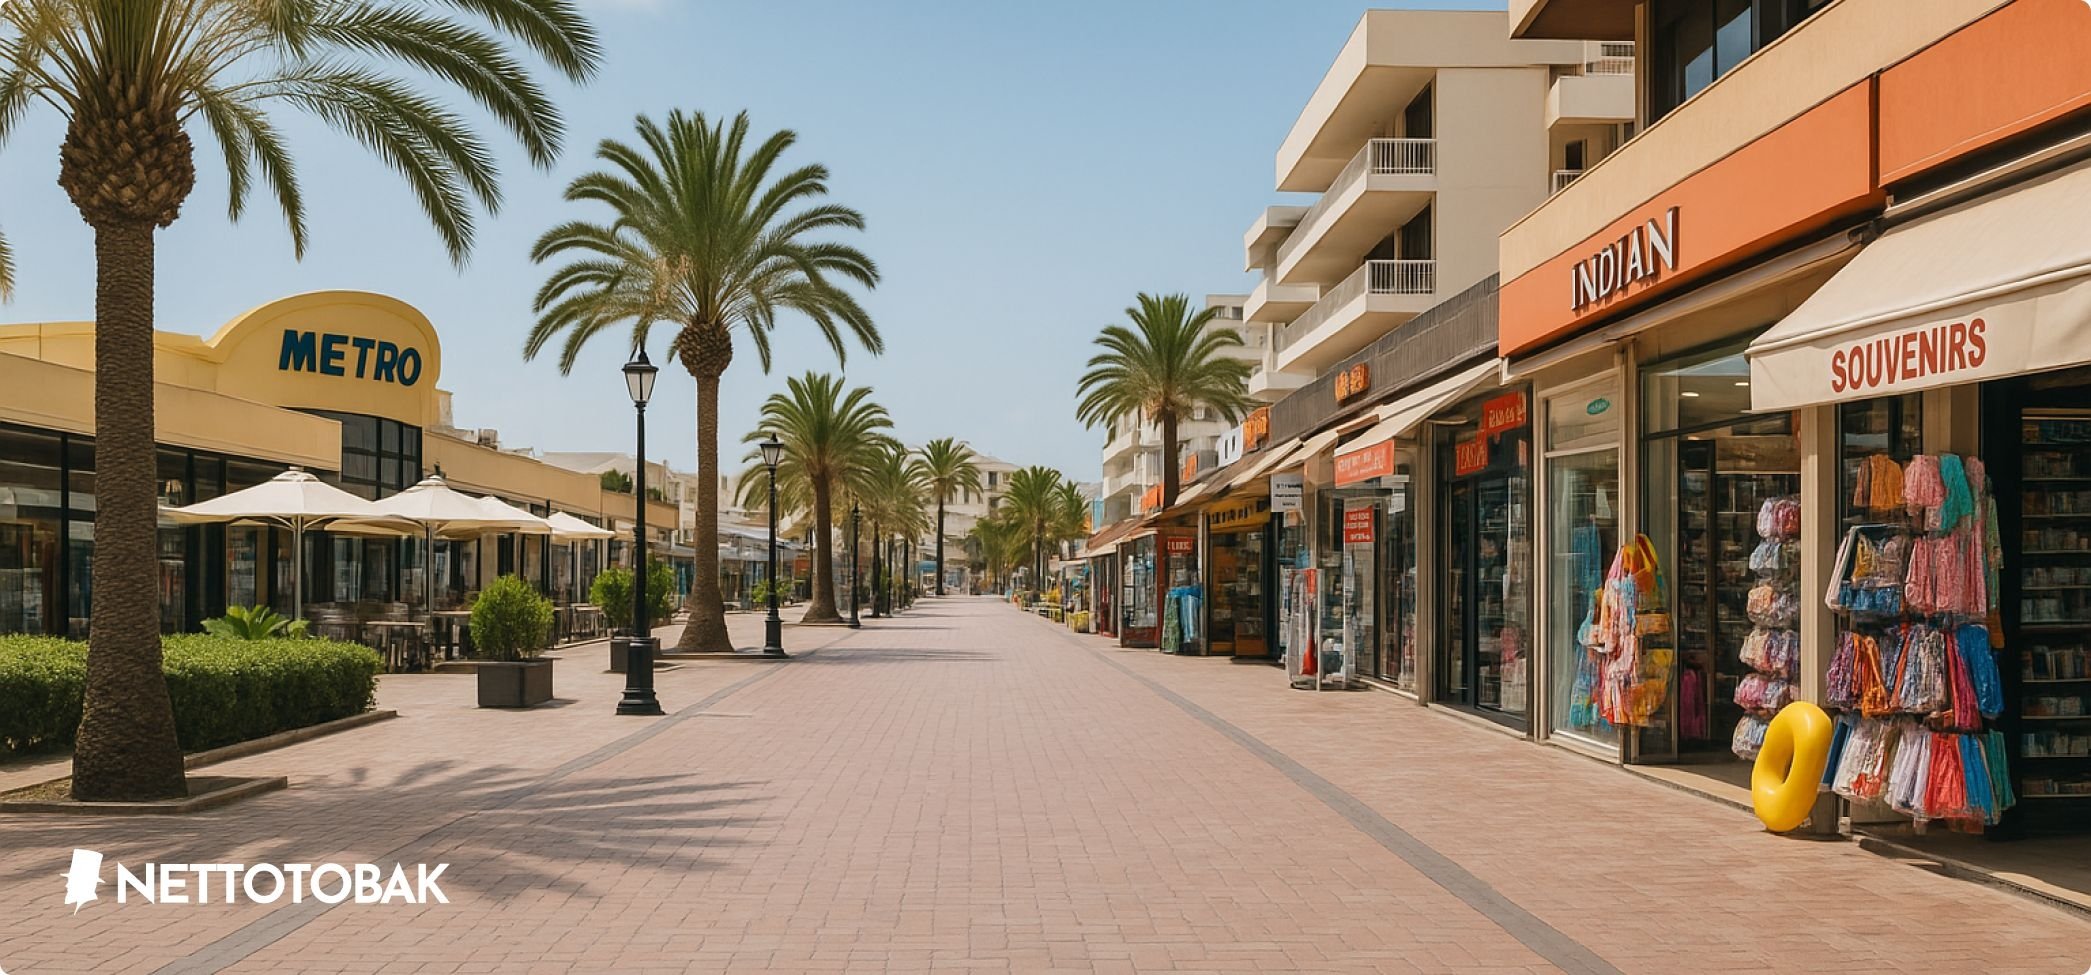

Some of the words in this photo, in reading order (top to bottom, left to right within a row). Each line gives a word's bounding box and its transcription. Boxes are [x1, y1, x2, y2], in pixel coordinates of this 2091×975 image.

[1571, 207, 1678, 311] INDIAN
[279, 329, 421, 386] METRO
[1831, 318, 1986, 393] SOUVENIRS
